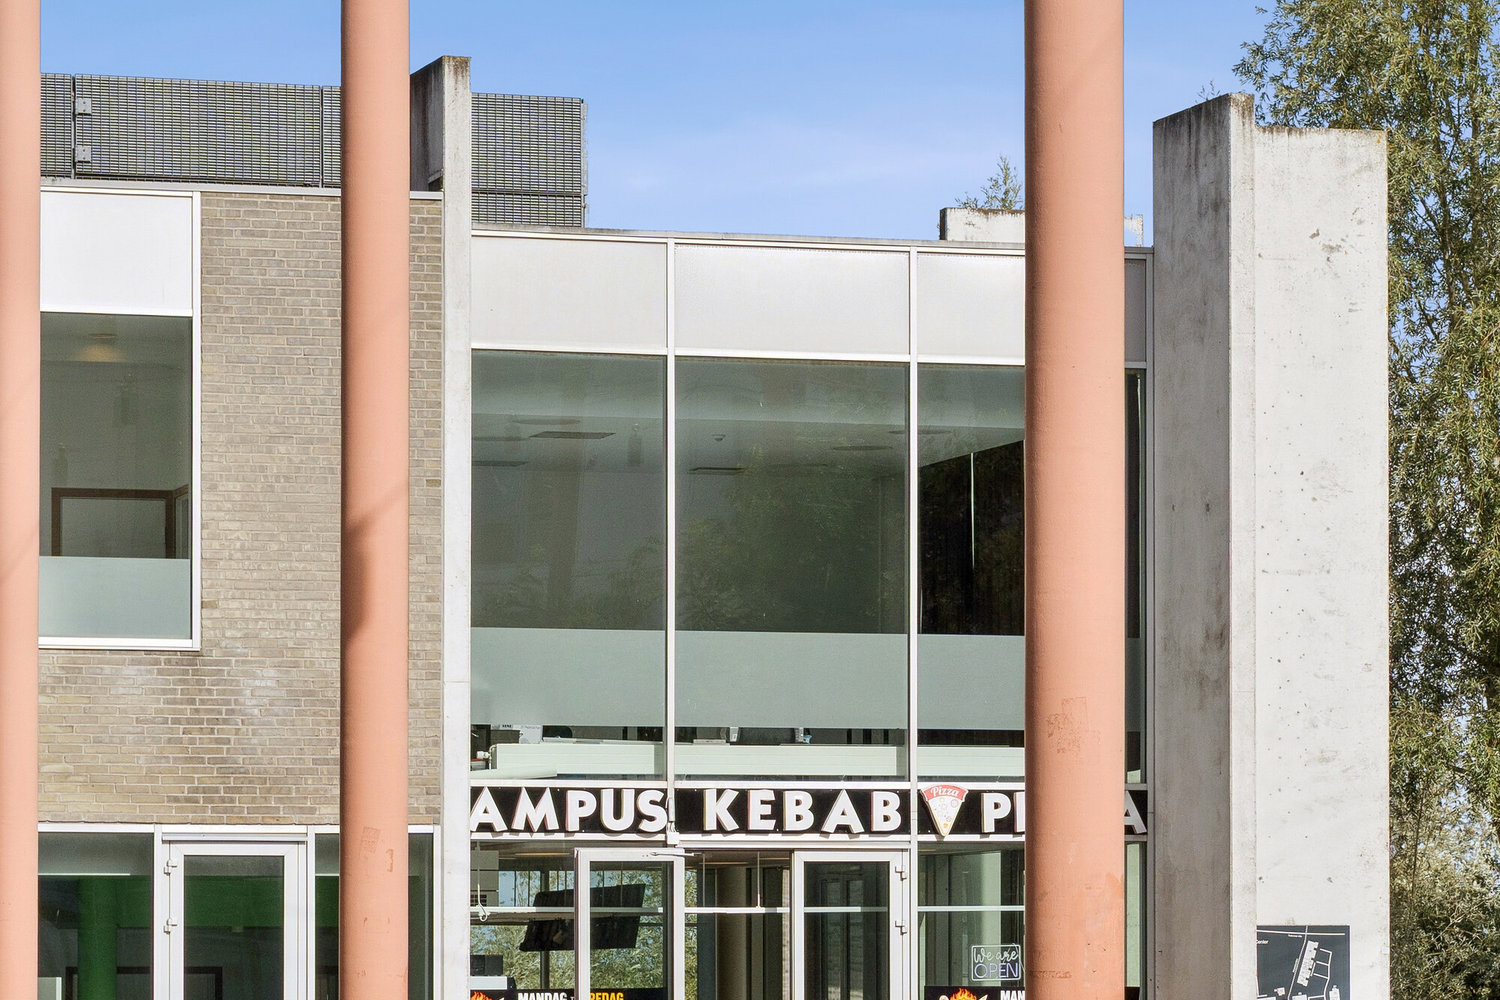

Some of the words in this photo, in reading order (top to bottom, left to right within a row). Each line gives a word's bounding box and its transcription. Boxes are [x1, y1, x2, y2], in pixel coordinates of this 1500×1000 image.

[929, 785, 959, 797] Pizza
[470, 786, 668, 832] AMPUS
[703, 788, 902, 833] KEBAB
[981, 789, 1147, 834] PIA
[973, 947, 993, 963] We
[995, 949, 1019, 961] are
[974, 962, 1019, 978] OPEN
